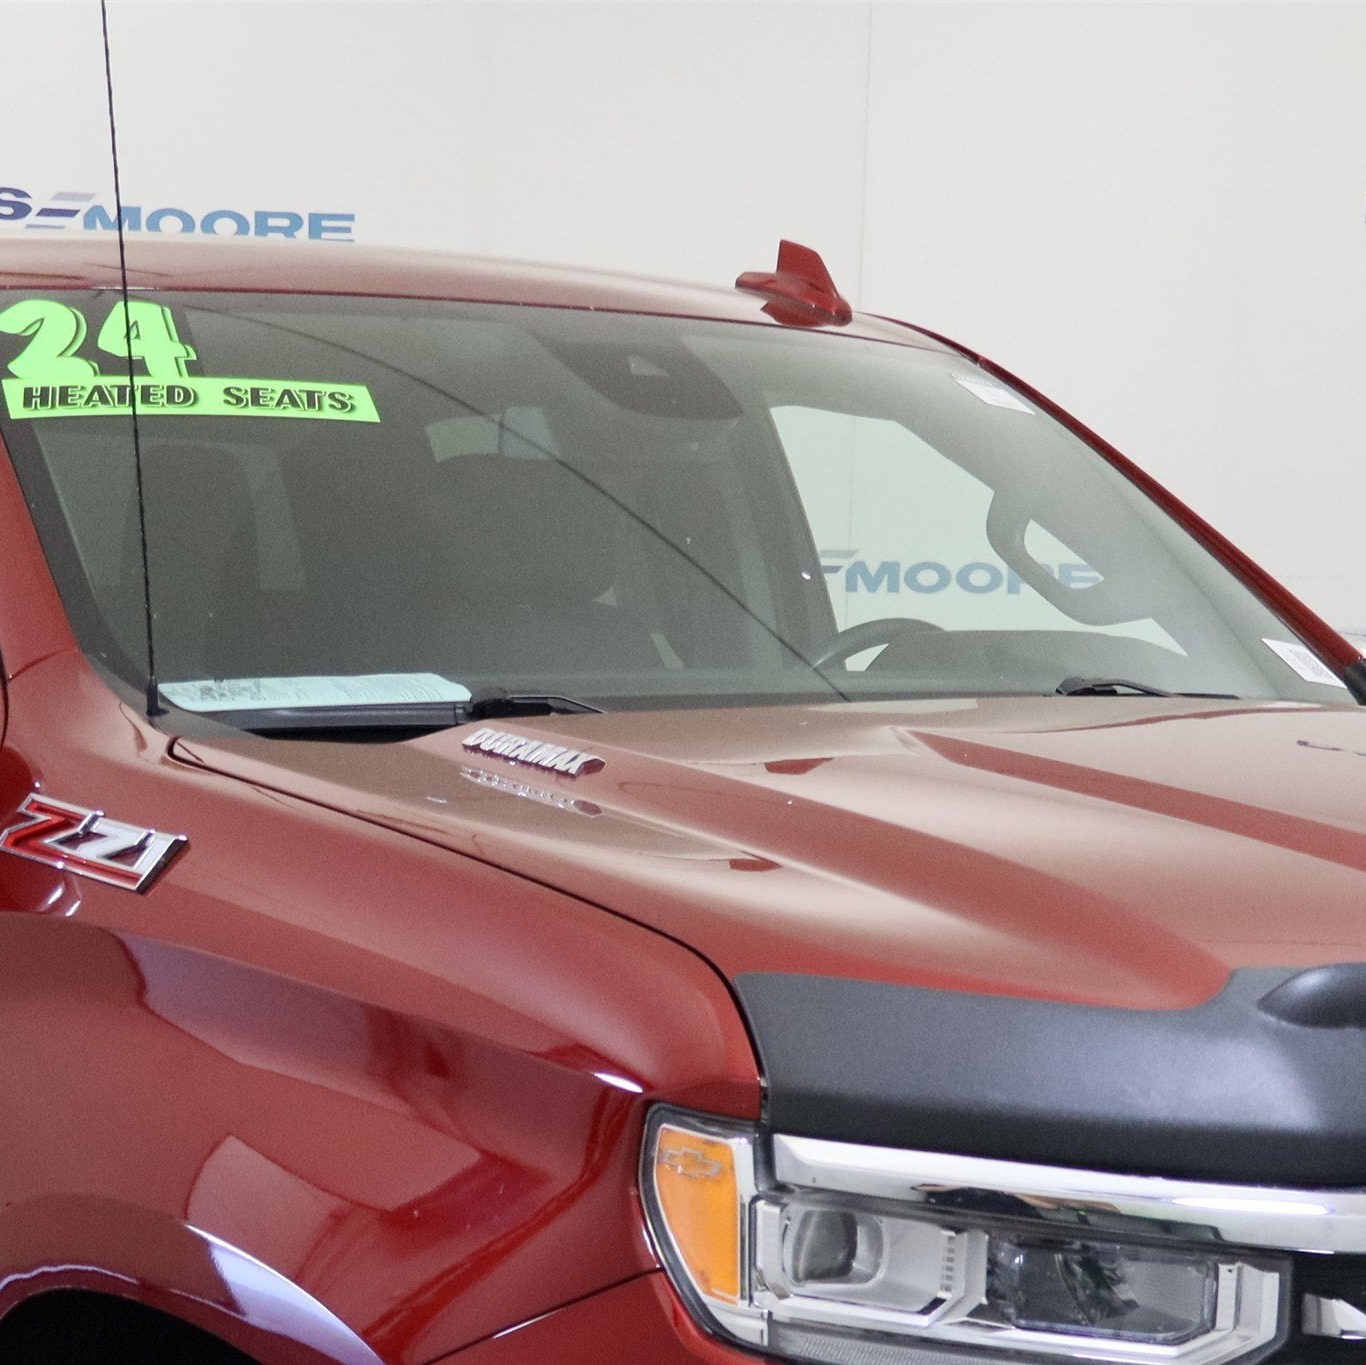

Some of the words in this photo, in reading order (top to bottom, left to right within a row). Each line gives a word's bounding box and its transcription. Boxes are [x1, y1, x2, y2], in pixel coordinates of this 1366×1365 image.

[83, 204, 356, 243] MOORE
[22, 383, 198, 410] HEATED
[223, 385, 356, 414] SEATS
